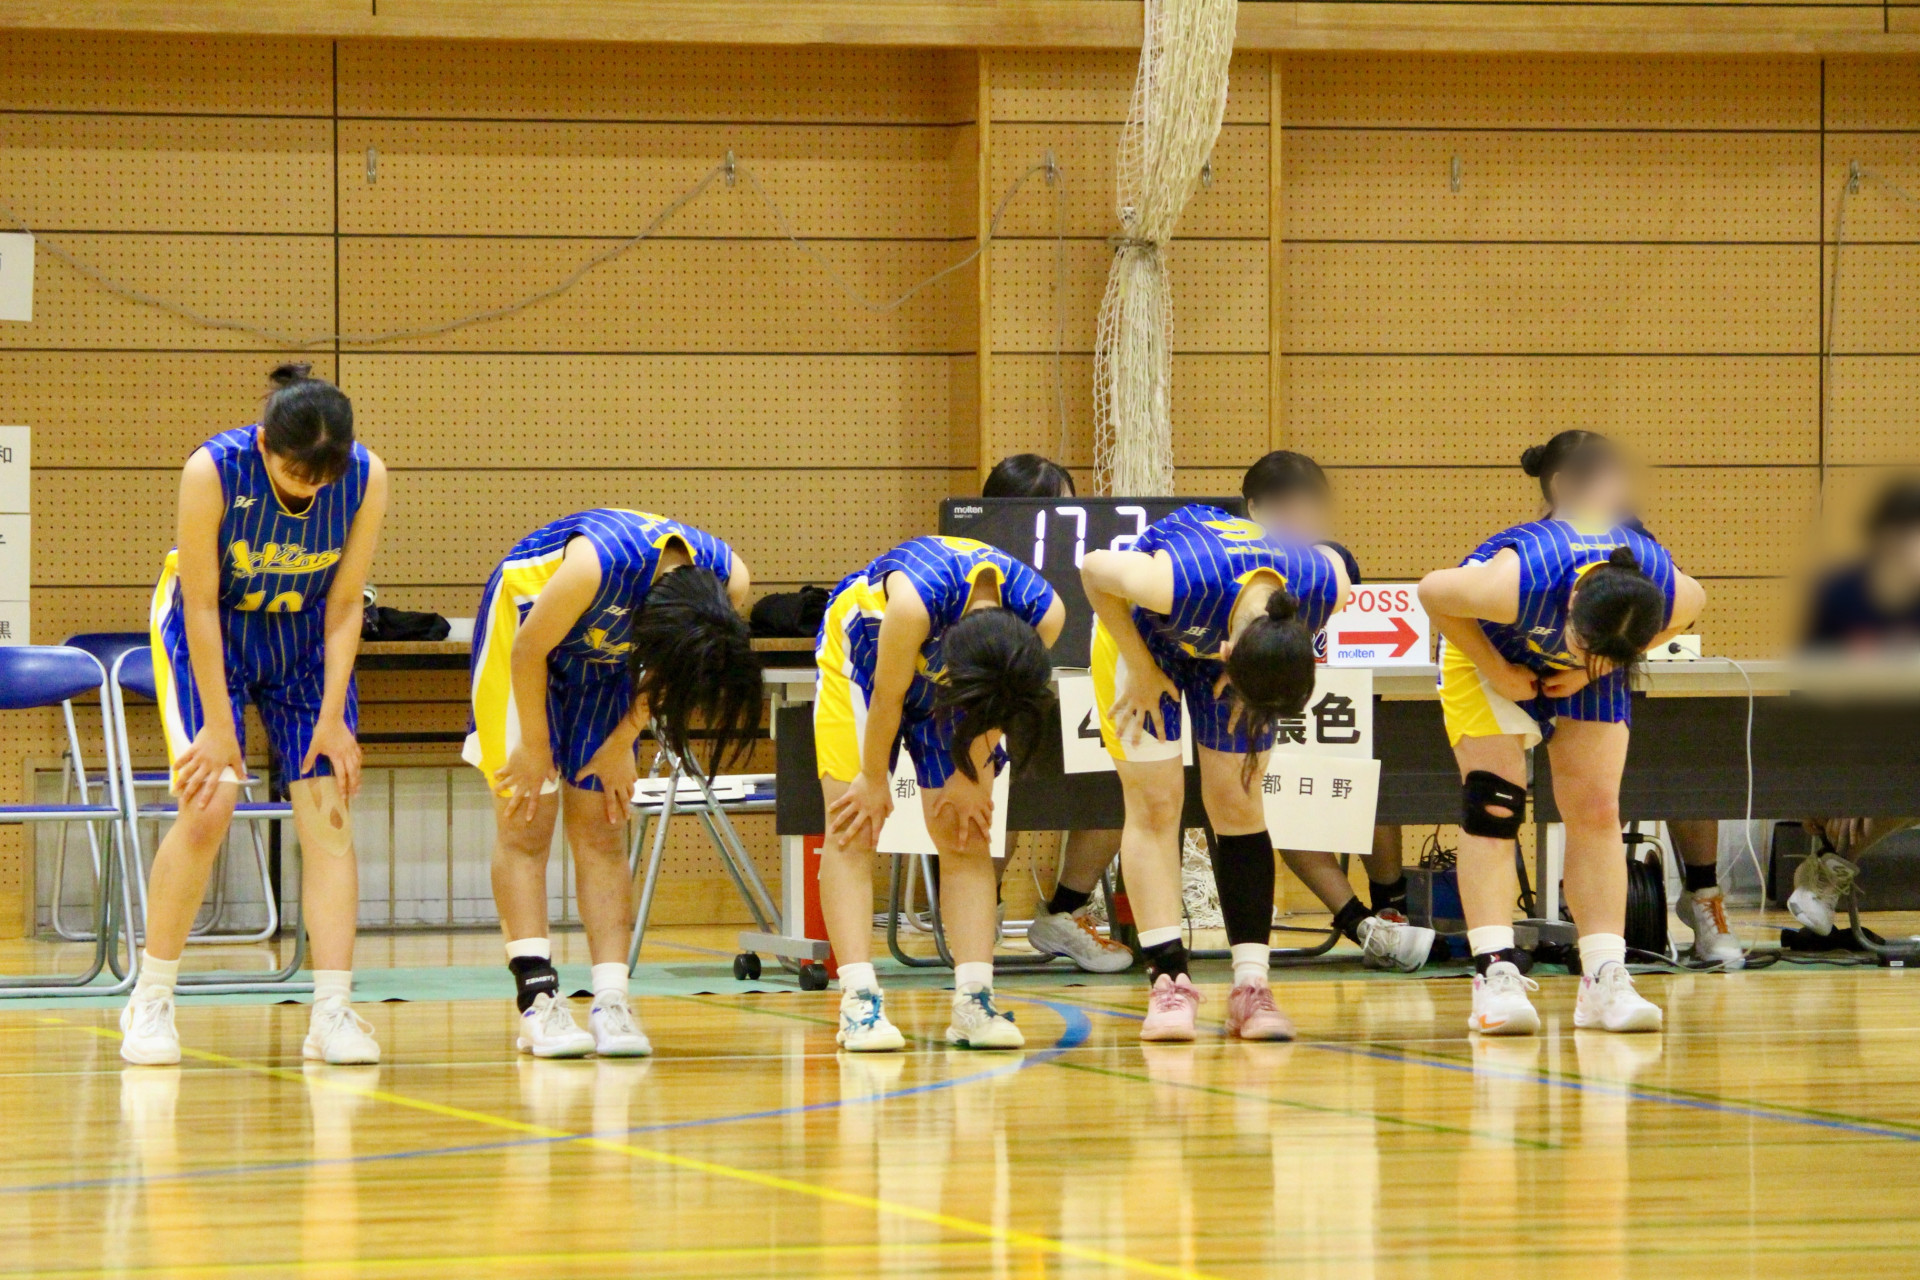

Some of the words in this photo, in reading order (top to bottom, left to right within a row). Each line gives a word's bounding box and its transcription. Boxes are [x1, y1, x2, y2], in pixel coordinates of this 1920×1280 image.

[954, 506, 983, 514] molten
[1342, 590, 1415, 613] POSS.
[1338, 648, 1375, 659] molten
[895, 776, 916, 799] 都
